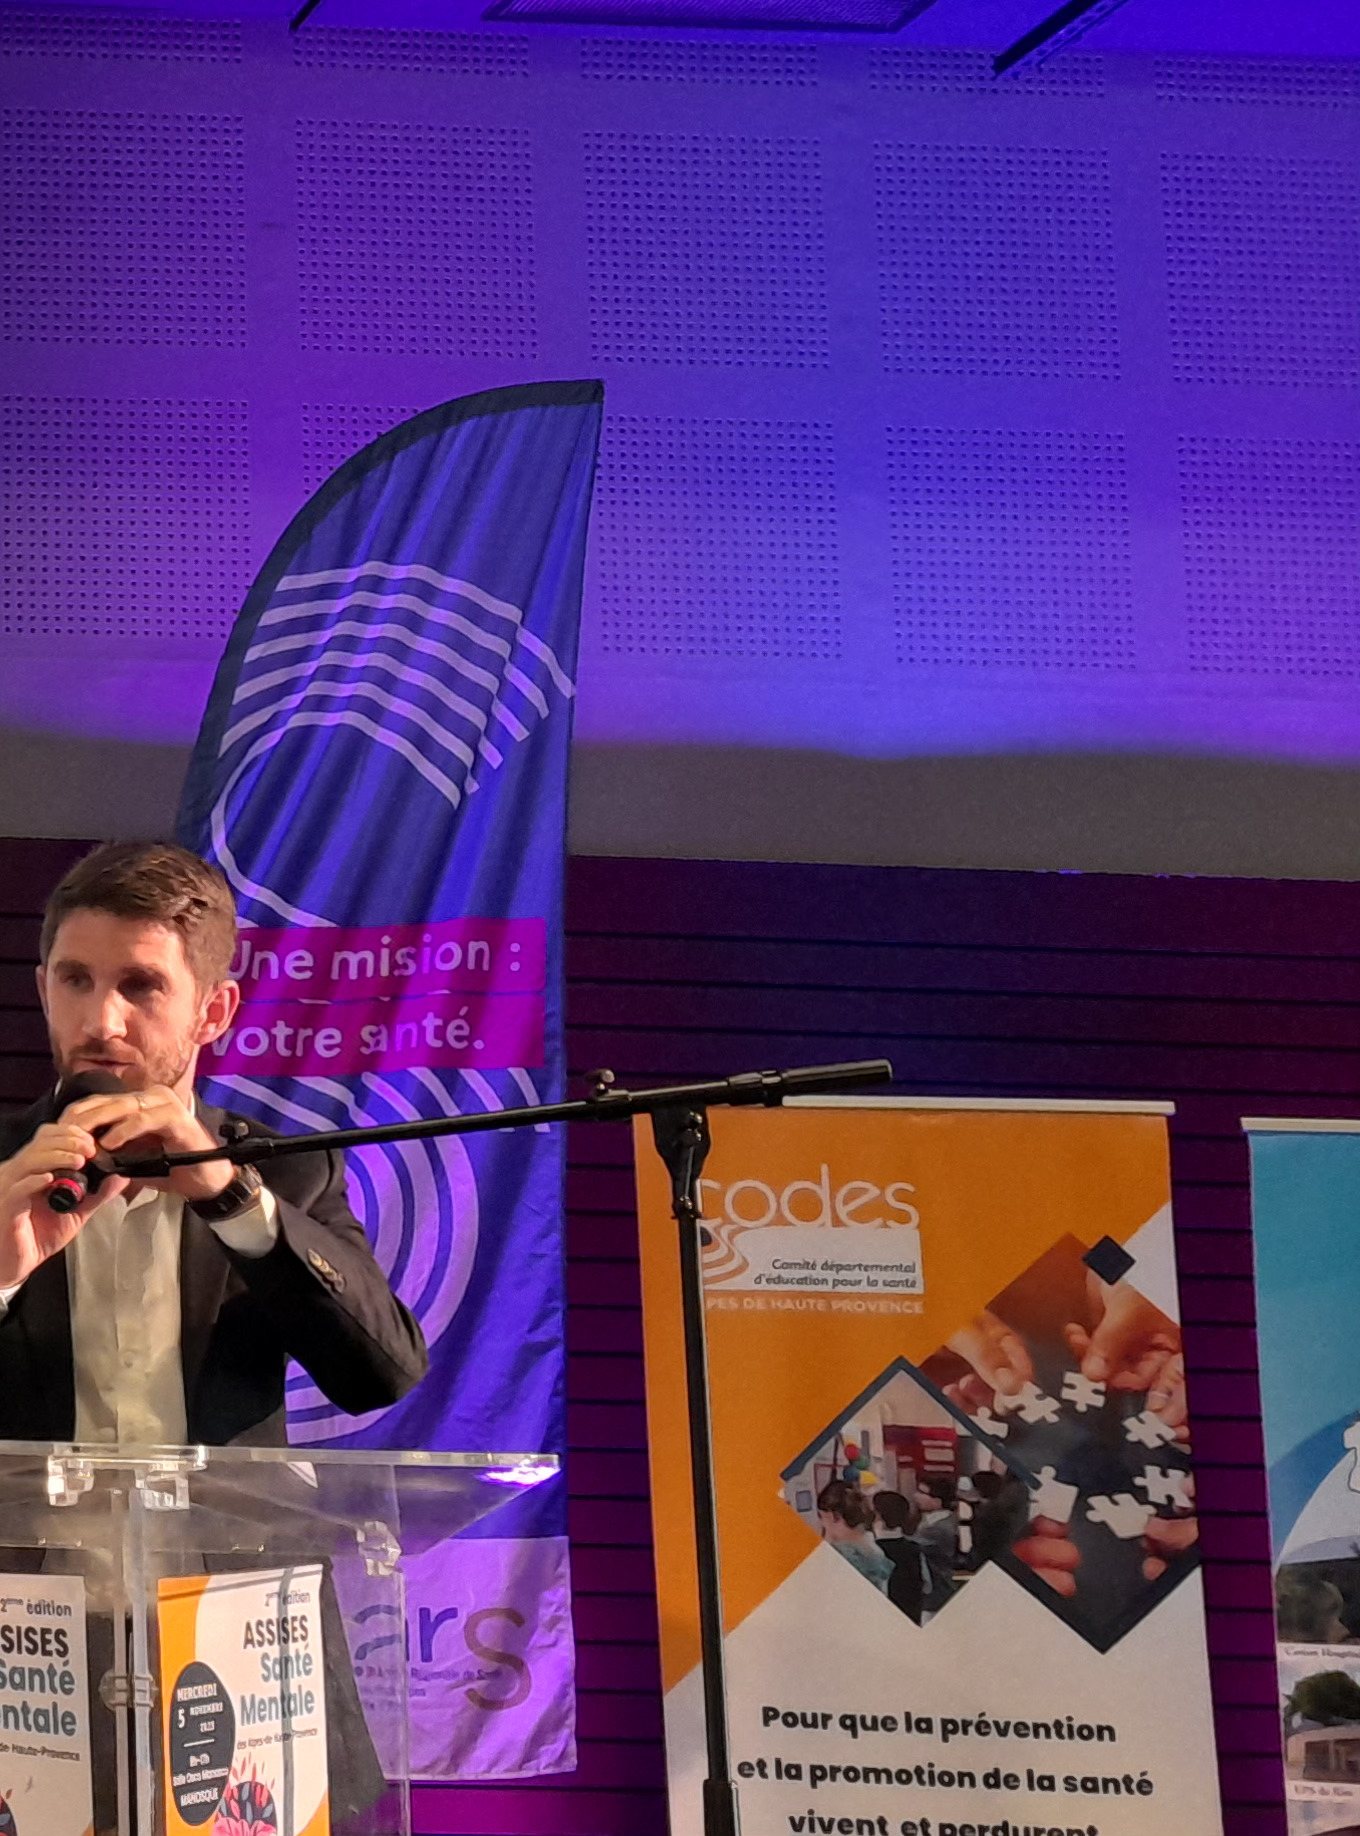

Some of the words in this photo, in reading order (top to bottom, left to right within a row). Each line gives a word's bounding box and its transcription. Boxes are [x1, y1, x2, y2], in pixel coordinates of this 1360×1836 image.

[228, 940, 315, 982] Une
[331, 932, 491, 982] mision
[212, 1022, 343, 1057] votre
[359, 1006, 486, 1055] santé.
[754, 1275, 829, 1286] d'éducation
[832, 1277, 862, 1288] pour
[866, 1276, 878, 1287] la
[883, 1277, 916, 1288] santé
[771, 1258, 817, 1270] Comité
[820, 1258, 915, 1274] départemental
[762, 1706, 833, 1731] Pour
[839, 1716, 898, 1739] que
[905, 1711, 933, 1735] la
[940, 1711, 1116, 1742] prévention
[737, 1759, 768, 1779] et
[775, 1758, 802, 1781] la
[810, 1761, 976, 1789] promotion
[982, 1768, 1021, 1791] de
[1027, 1769, 1056, 1792] la
[1063, 1771, 1154, 1796] santé
[789, 1809, 888, 1836] vivent
[900, 1818, 931, 1836] et
[939, 1820, 1098, 1836] perdurent
